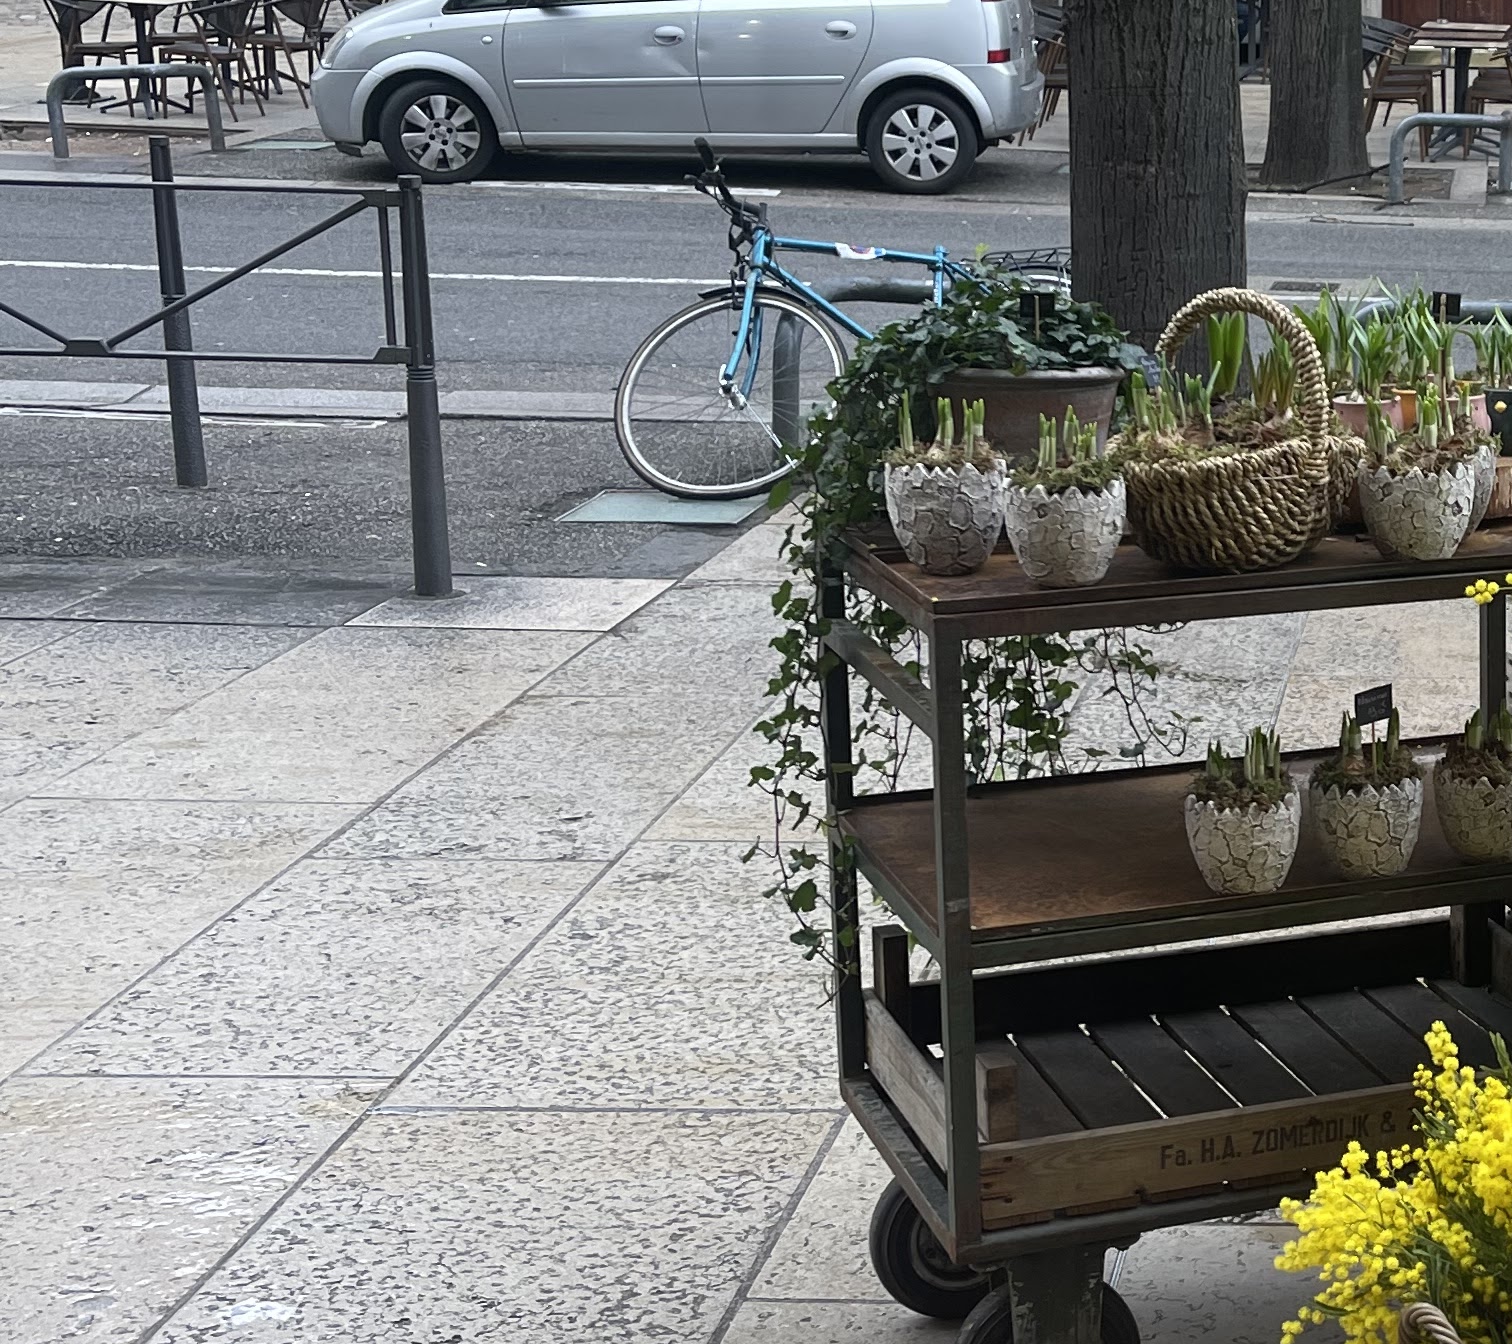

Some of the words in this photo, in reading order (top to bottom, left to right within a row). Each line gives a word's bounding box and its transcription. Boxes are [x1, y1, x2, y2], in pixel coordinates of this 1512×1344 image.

[1160, 1144, 1193, 1170] Fa.
[1201, 1134, 1243, 1164] H.A.
[1251, 1113, 1369, 1156] ZOMERDIJK
[1380, 1110, 1396, 1134] &
